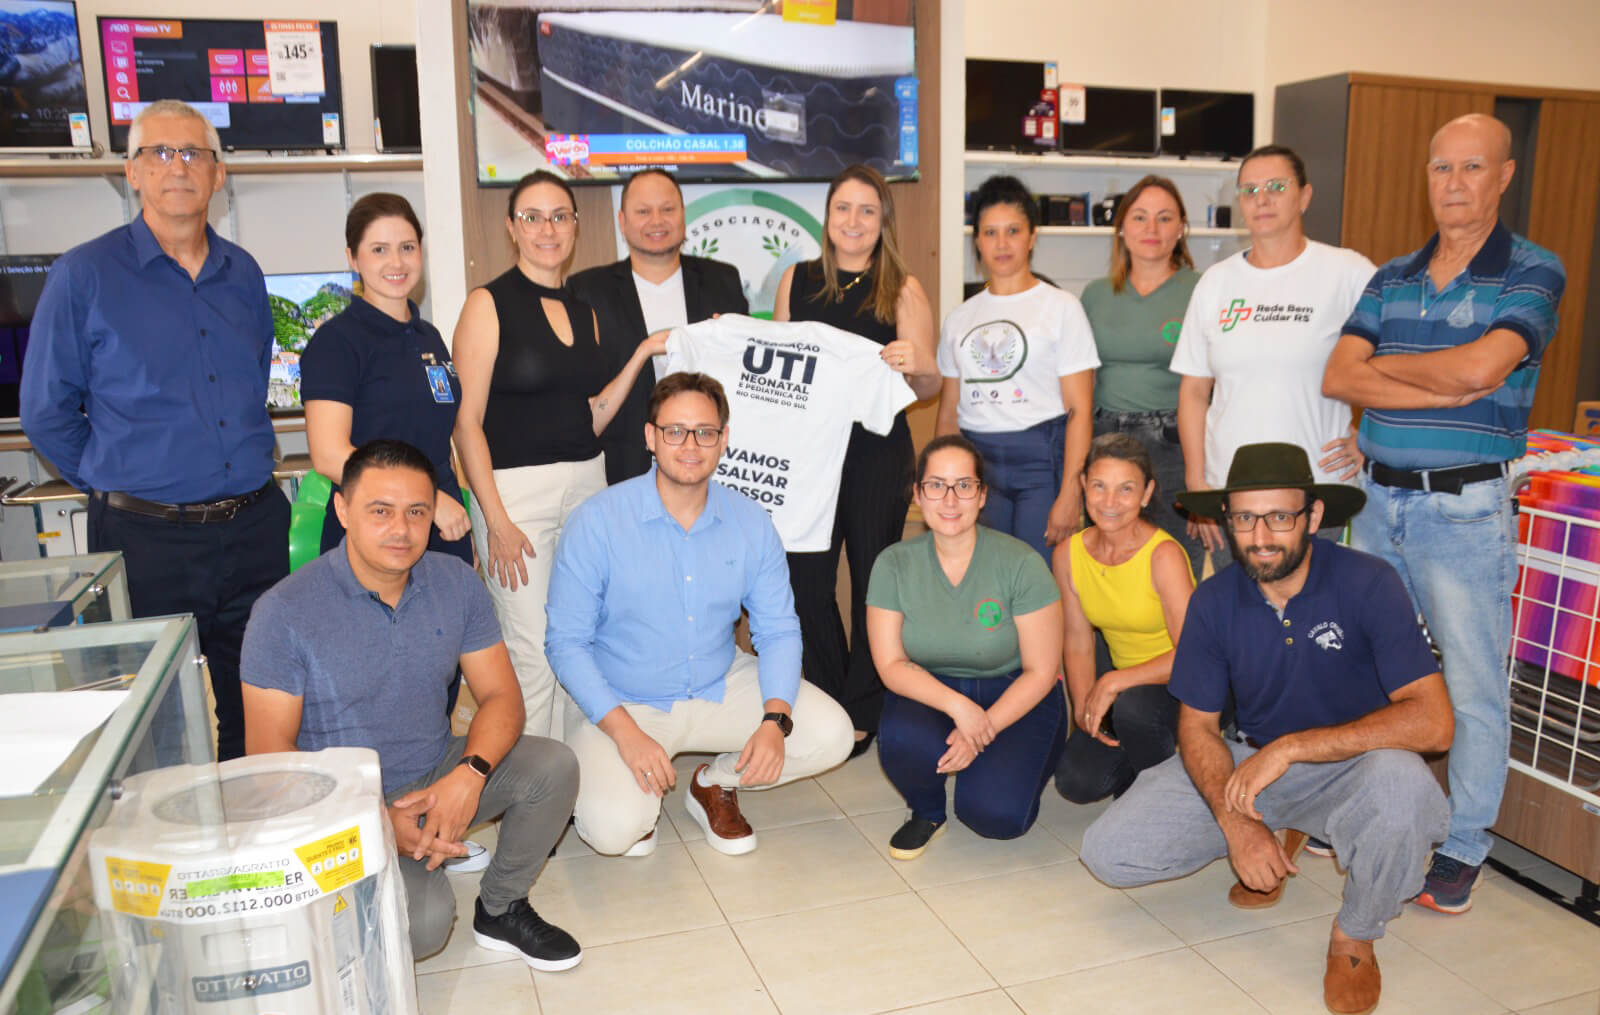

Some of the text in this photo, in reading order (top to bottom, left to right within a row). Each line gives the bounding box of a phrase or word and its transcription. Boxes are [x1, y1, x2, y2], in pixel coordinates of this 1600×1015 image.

[283, 44, 308, 60] 145
[625, 138, 681, 150] COLCHÃO
[683, 139, 720, 150] CASAL
[683, 215, 801, 242] SSOCIAÇÃO
[1253, 313, 1310, 323] Cuidar RS
[1255, 304, 1314, 314] Rede Bem
[742, 344, 818, 385] UTI
[740, 371, 810, 395] NEONATAL
[736, 389, 749, 397] RIO
[750, 393, 780, 404] GRANDE
[793, 401, 808, 410] SUL
[795, 393, 810, 402] DO
[725, 446, 792, 472] VAMOS
[716, 462, 789, 490] SALVAR
